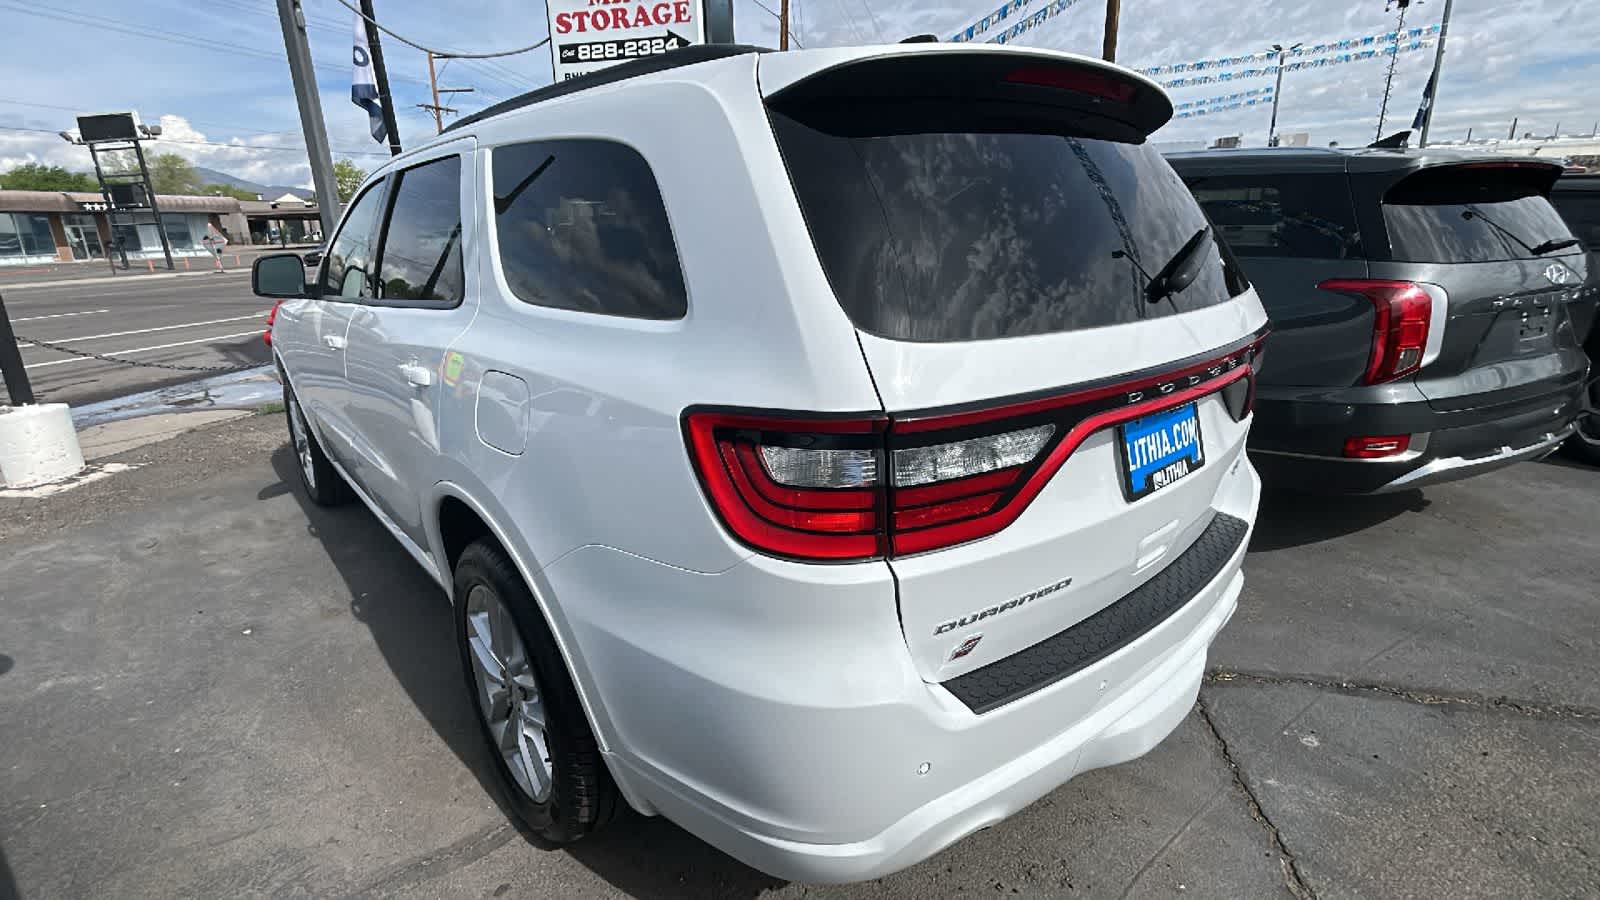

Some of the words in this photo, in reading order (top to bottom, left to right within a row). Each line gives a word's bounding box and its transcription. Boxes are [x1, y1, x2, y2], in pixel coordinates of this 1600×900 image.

[556, 1, 692, 34] STORAGE
[577, 37, 680, 61] 828-2324
[1126, 416, 1198, 472] LITHIA.COM
[933, 577, 1073, 636] DURANGO
